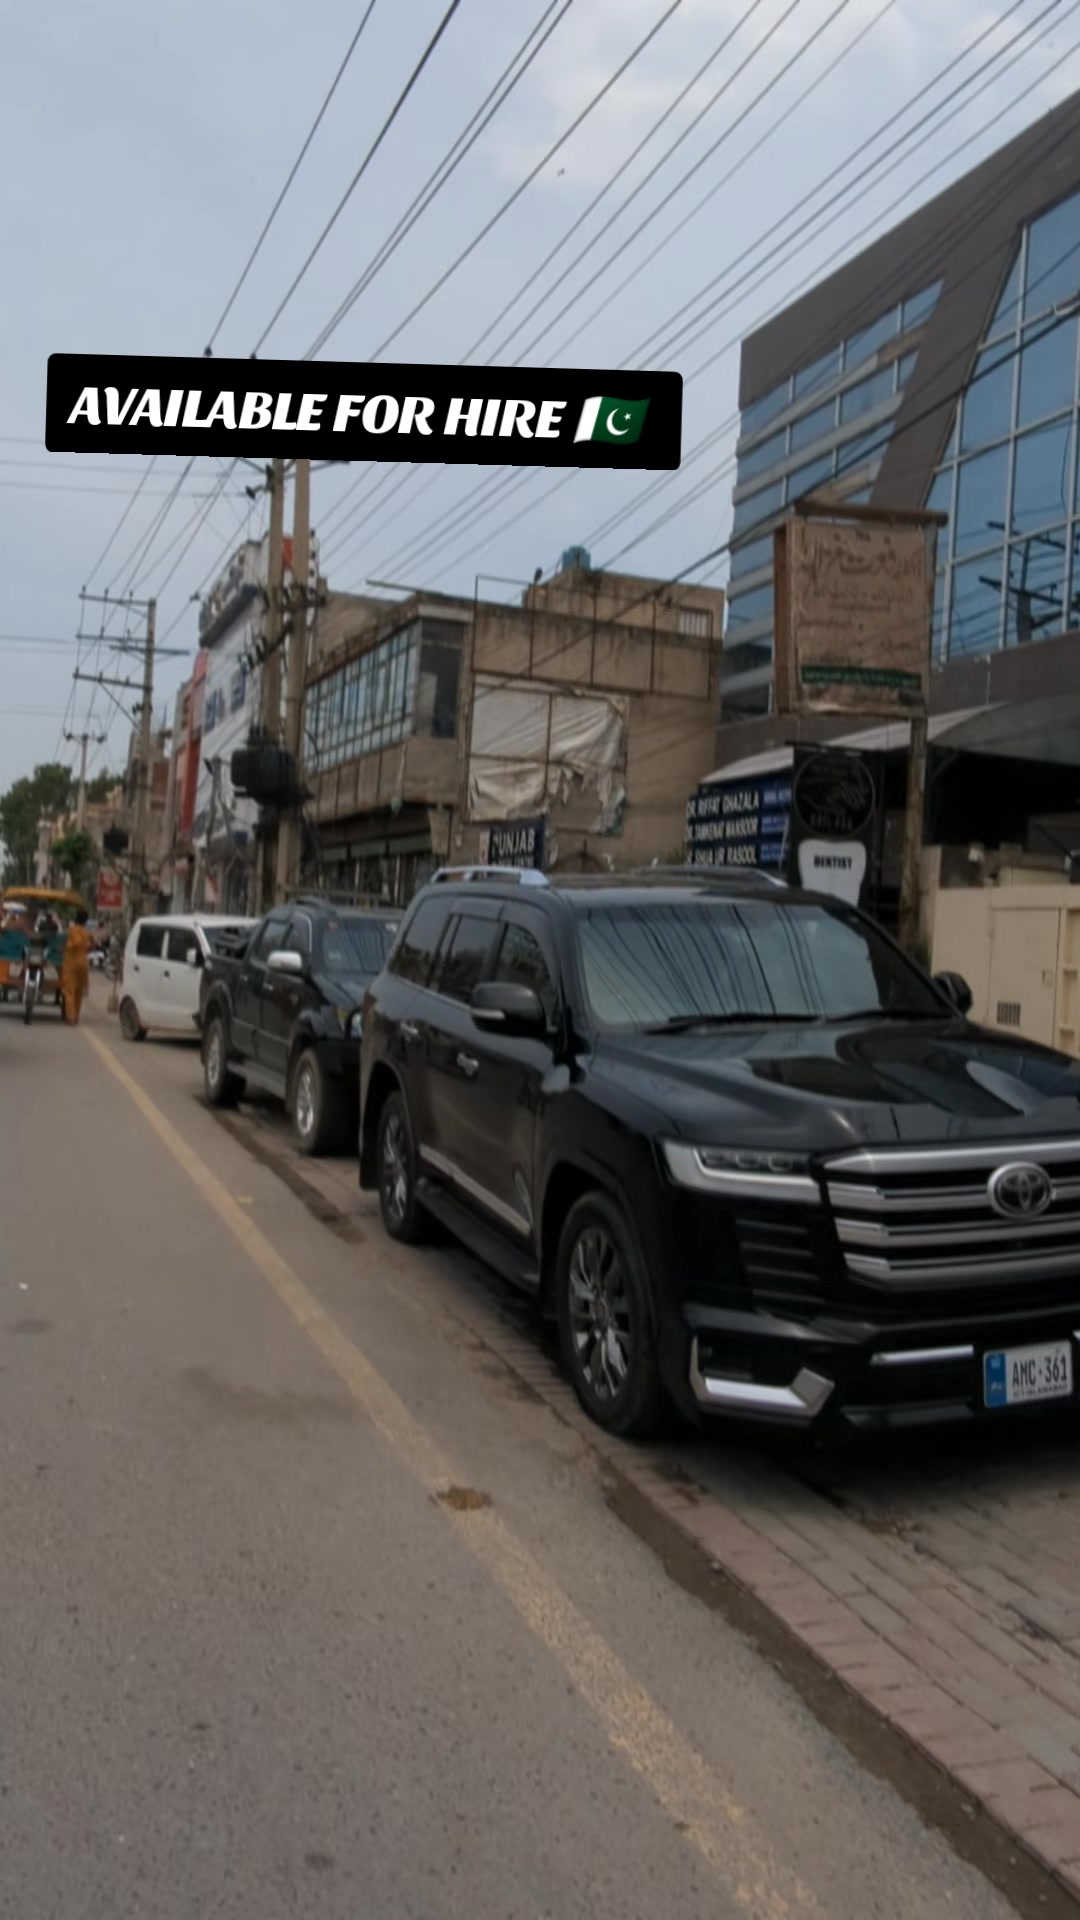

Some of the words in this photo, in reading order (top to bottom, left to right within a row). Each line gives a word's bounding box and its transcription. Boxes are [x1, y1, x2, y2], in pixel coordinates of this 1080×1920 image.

[722, 791, 759, 815] GHAZALA
[492, 828, 535, 857] PUNJAB
[727, 844, 758, 865] RASOOL
[814, 855, 853, 871] DENTIST
